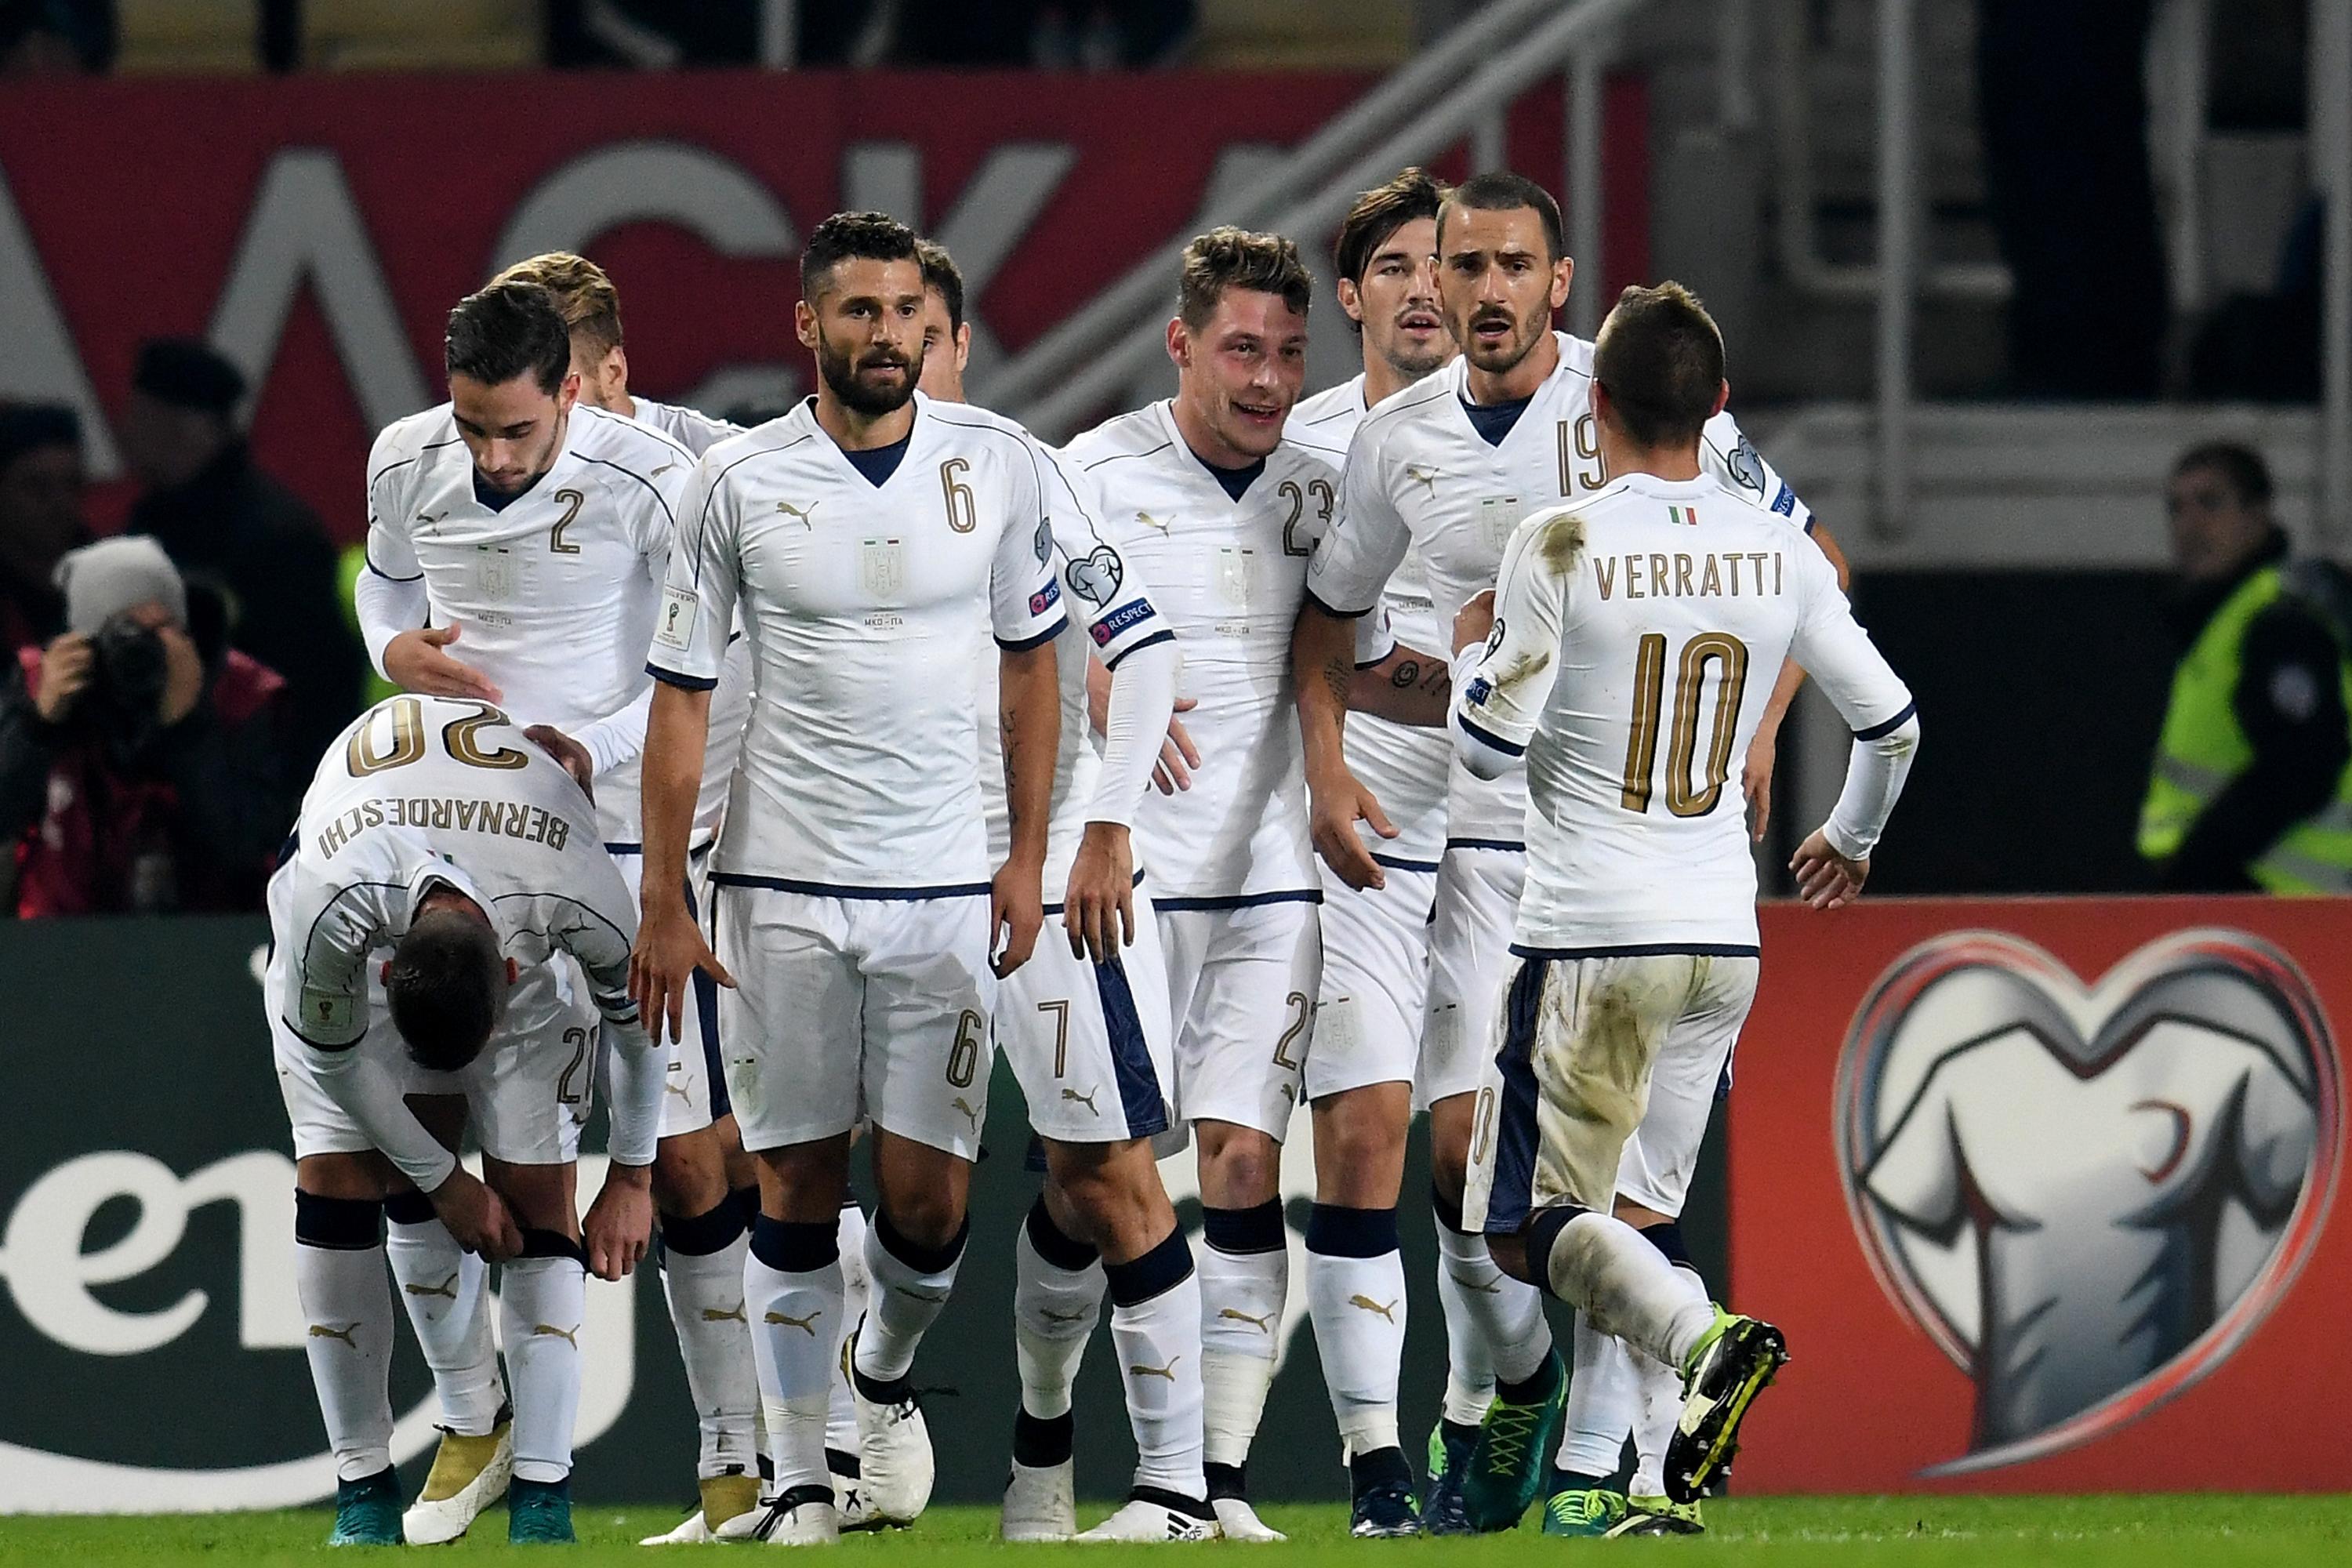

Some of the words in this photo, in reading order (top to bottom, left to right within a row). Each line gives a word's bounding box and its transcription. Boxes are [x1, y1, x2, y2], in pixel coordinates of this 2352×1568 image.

[1557, 412, 1606, 497] 19
[550, 488, 584, 554] 2
[941, 458, 977, 533] 6
[1278, 479, 1333, 557] 23
[1593, 551, 1782, 602] VERRATTI
[1108, 602, 1152, 631] RESPECT
[347, 696, 529, 778] 20
[1621, 632, 1749, 818] 10
[318, 797, 570, 860] BERNARDESCHI
[946, 1009, 982, 1088] 6
[1037, 1000, 1069, 1079] 7
[1272, 991, 1317, 1071] 2
